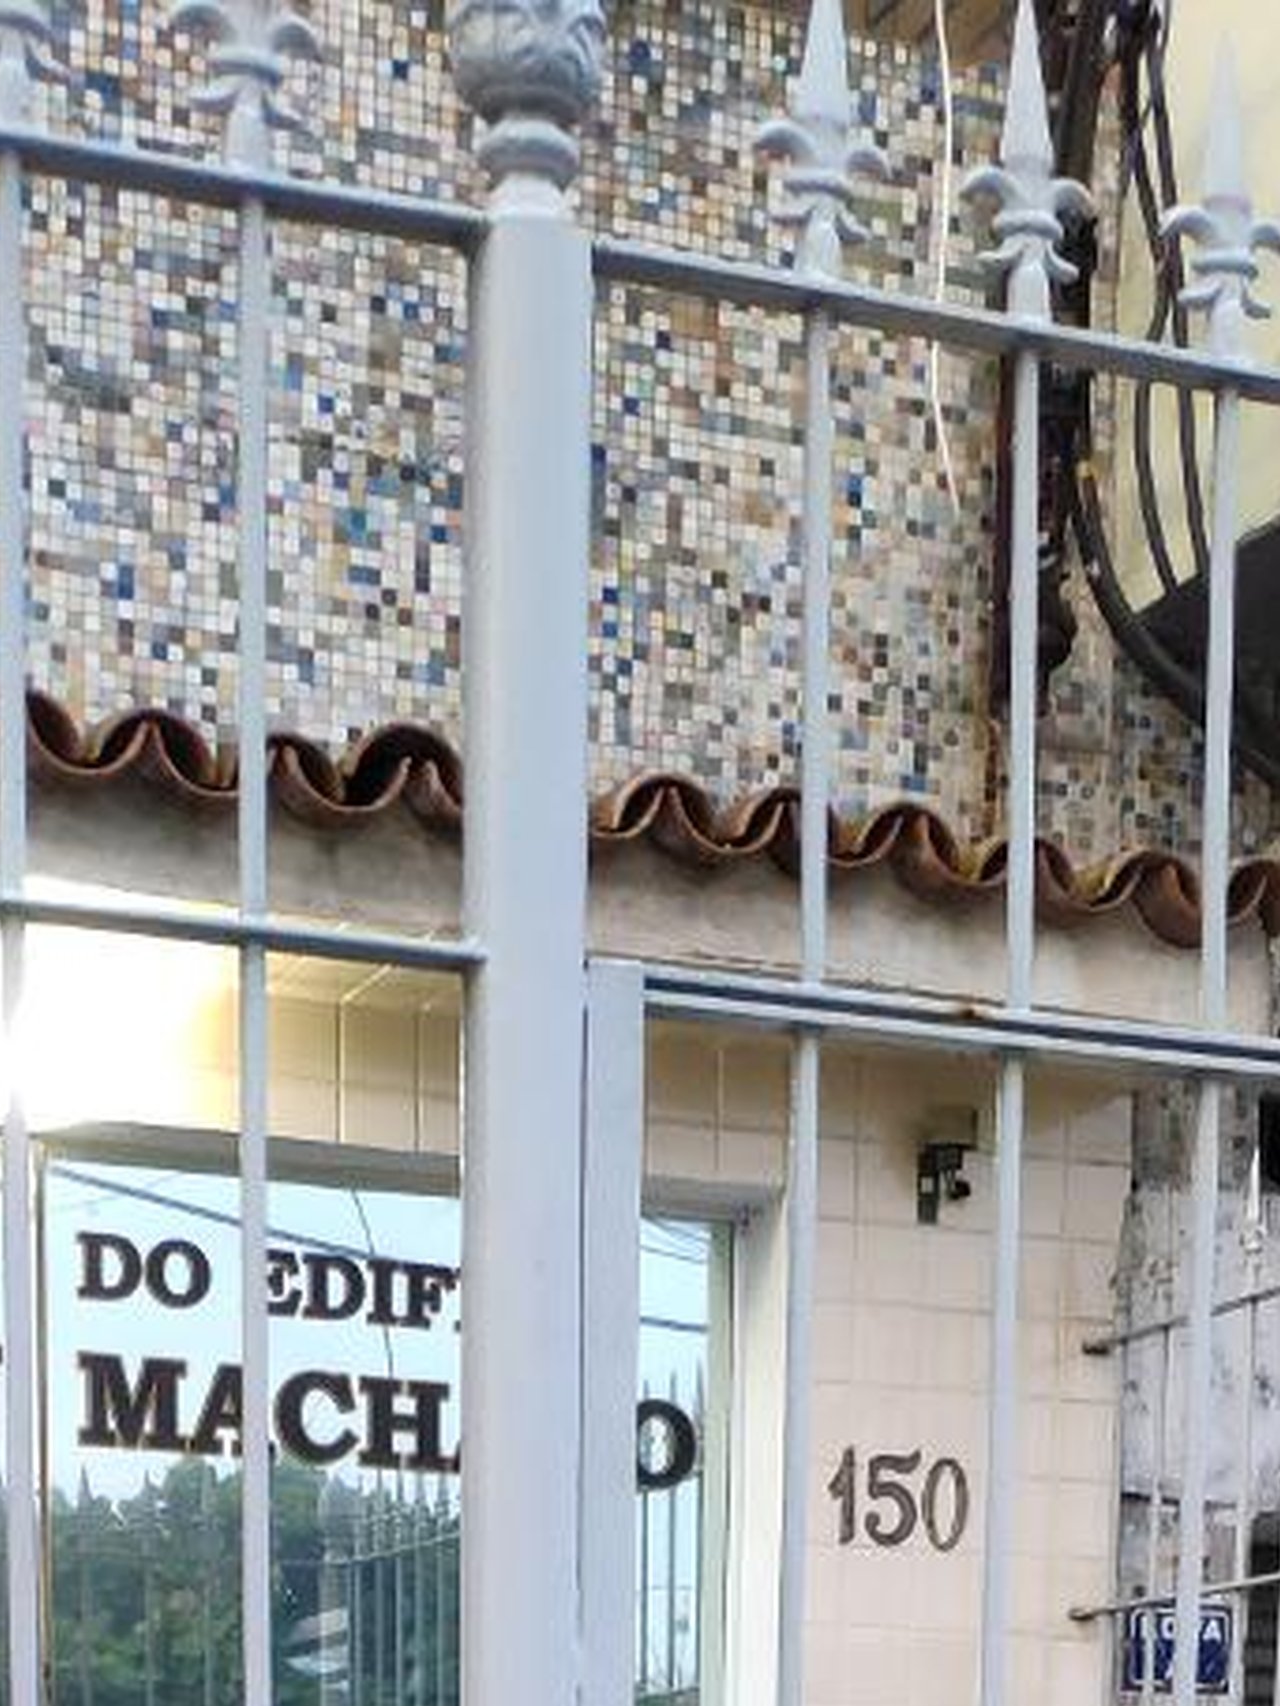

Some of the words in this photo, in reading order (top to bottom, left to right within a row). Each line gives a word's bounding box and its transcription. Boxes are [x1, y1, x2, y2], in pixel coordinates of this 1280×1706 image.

[77, 1231, 211, 1309] DO
[77, 1351, 697, 1491] MACHO
[827, 1445, 970, 1552] 150
